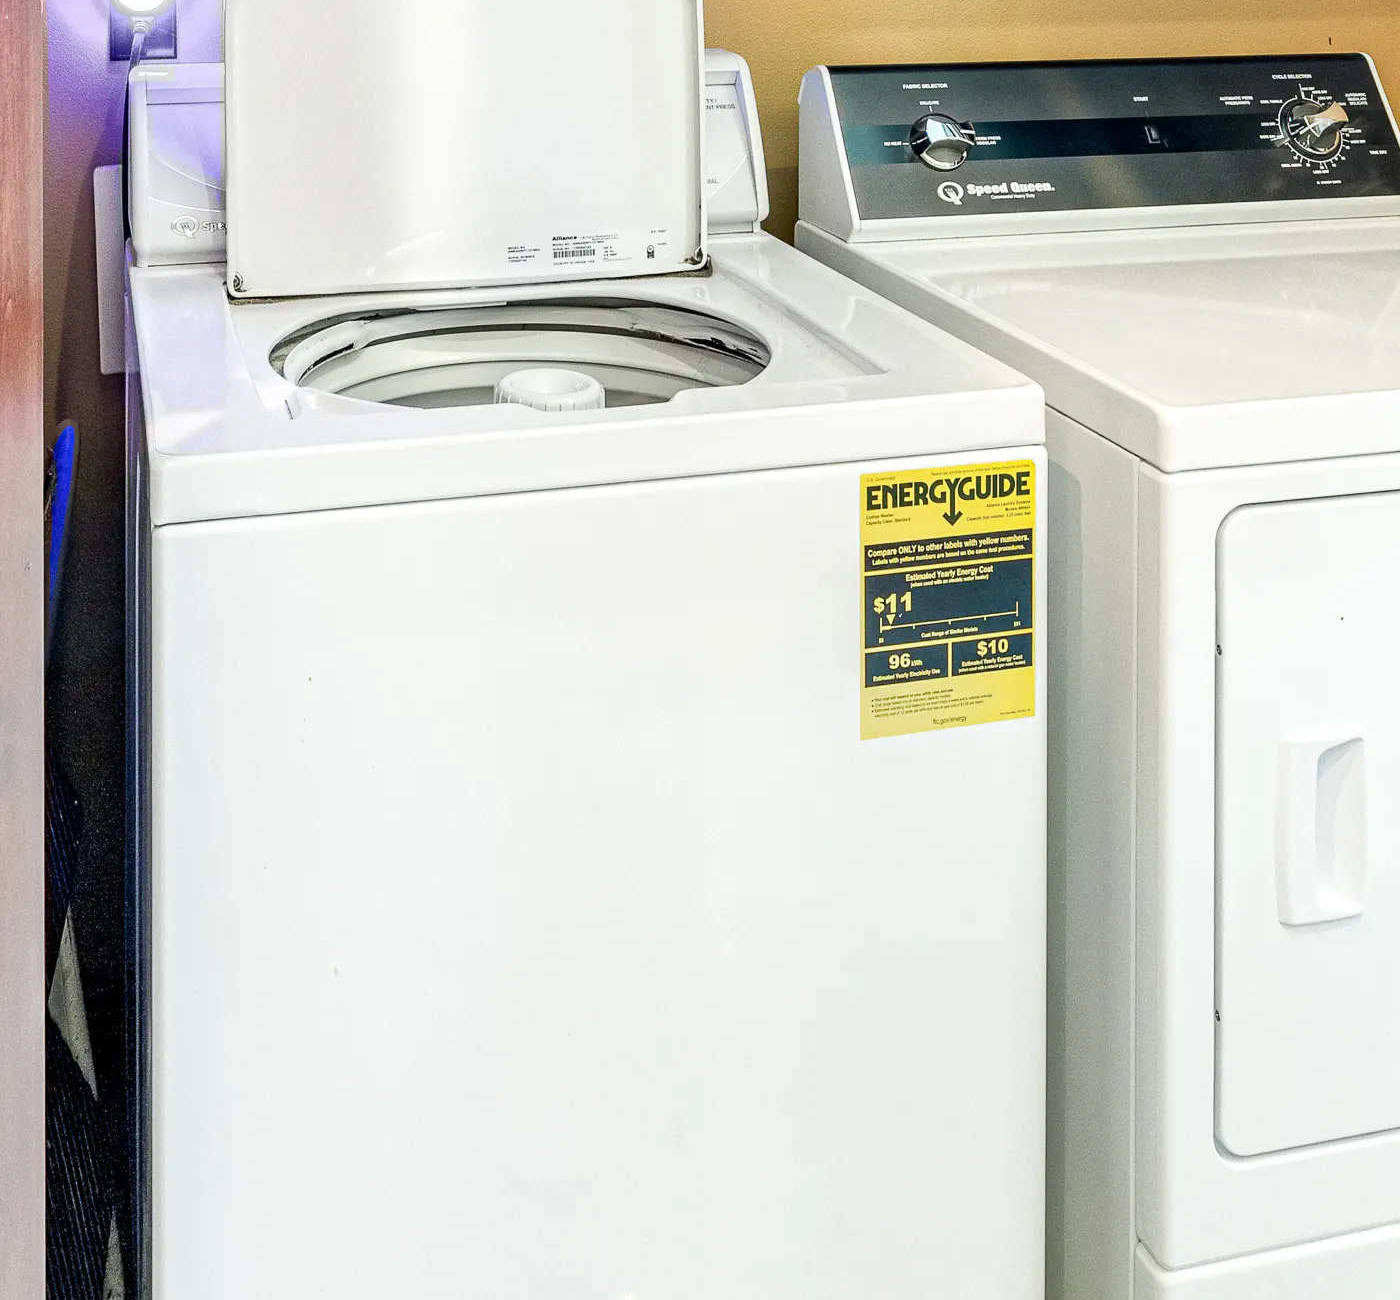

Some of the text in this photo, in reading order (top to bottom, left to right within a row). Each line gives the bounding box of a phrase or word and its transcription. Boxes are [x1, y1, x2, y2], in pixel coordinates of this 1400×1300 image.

[966, 182, 1008, 196] Speed
[866, 471, 1030, 511] ENERGYGUIDE
[868, 549, 897, 558] Compare
[898, 545, 917, 554] ONLY
[926, 543, 943, 551] other
[944, 540, 963, 549] labels
[964, 539, 978, 547] with
[979, 537, 999, 547] yellow
[1000, 534, 1029, 543] numbers.
[998, 545, 1025, 553] procedures.
[905, 565, 993, 582] Estimated Yearly Energy Cost
[874, 591, 912, 614] $11
[977, 638, 1009, 657] $10
[889, 653, 911, 670] 96
[873, 674, 895, 682] Estimated
